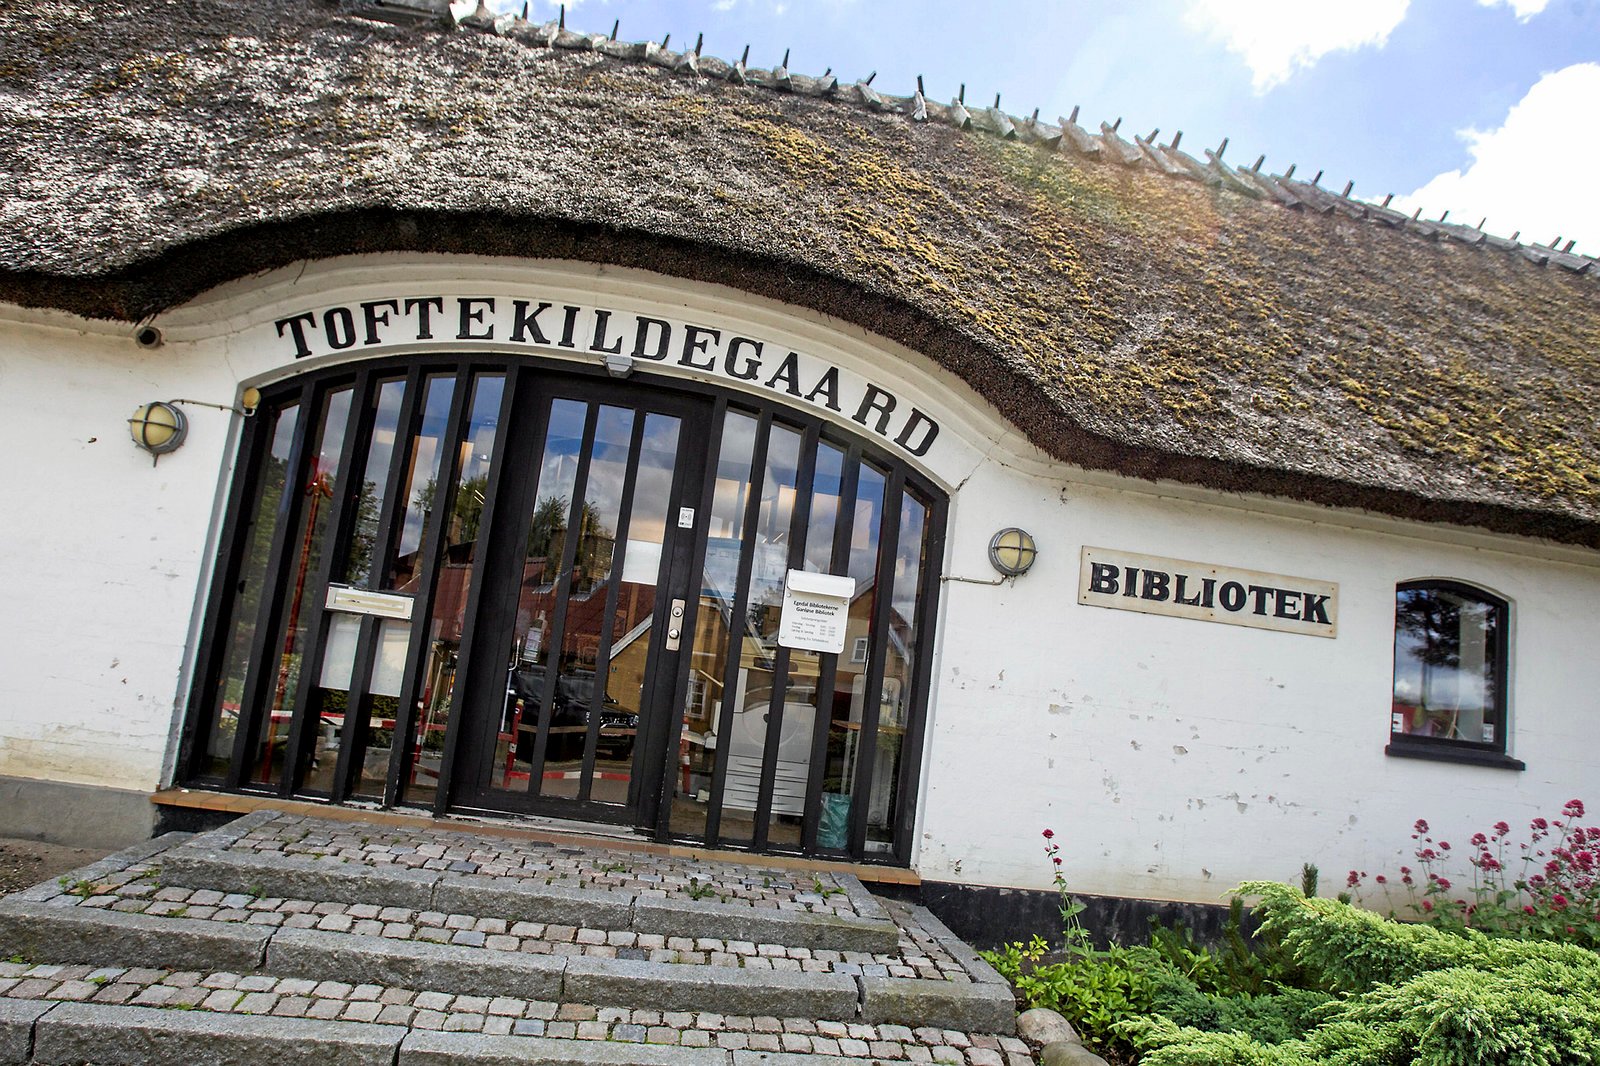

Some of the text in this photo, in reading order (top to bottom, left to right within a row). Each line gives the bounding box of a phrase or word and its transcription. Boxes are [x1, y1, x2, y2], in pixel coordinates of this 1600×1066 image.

[275, 297, 940, 458] TOFTEKILDEGAARD
[809, 602, 839, 611] Bibliotekerne
[1088, 562, 1332, 625] BIBLIOTEK
